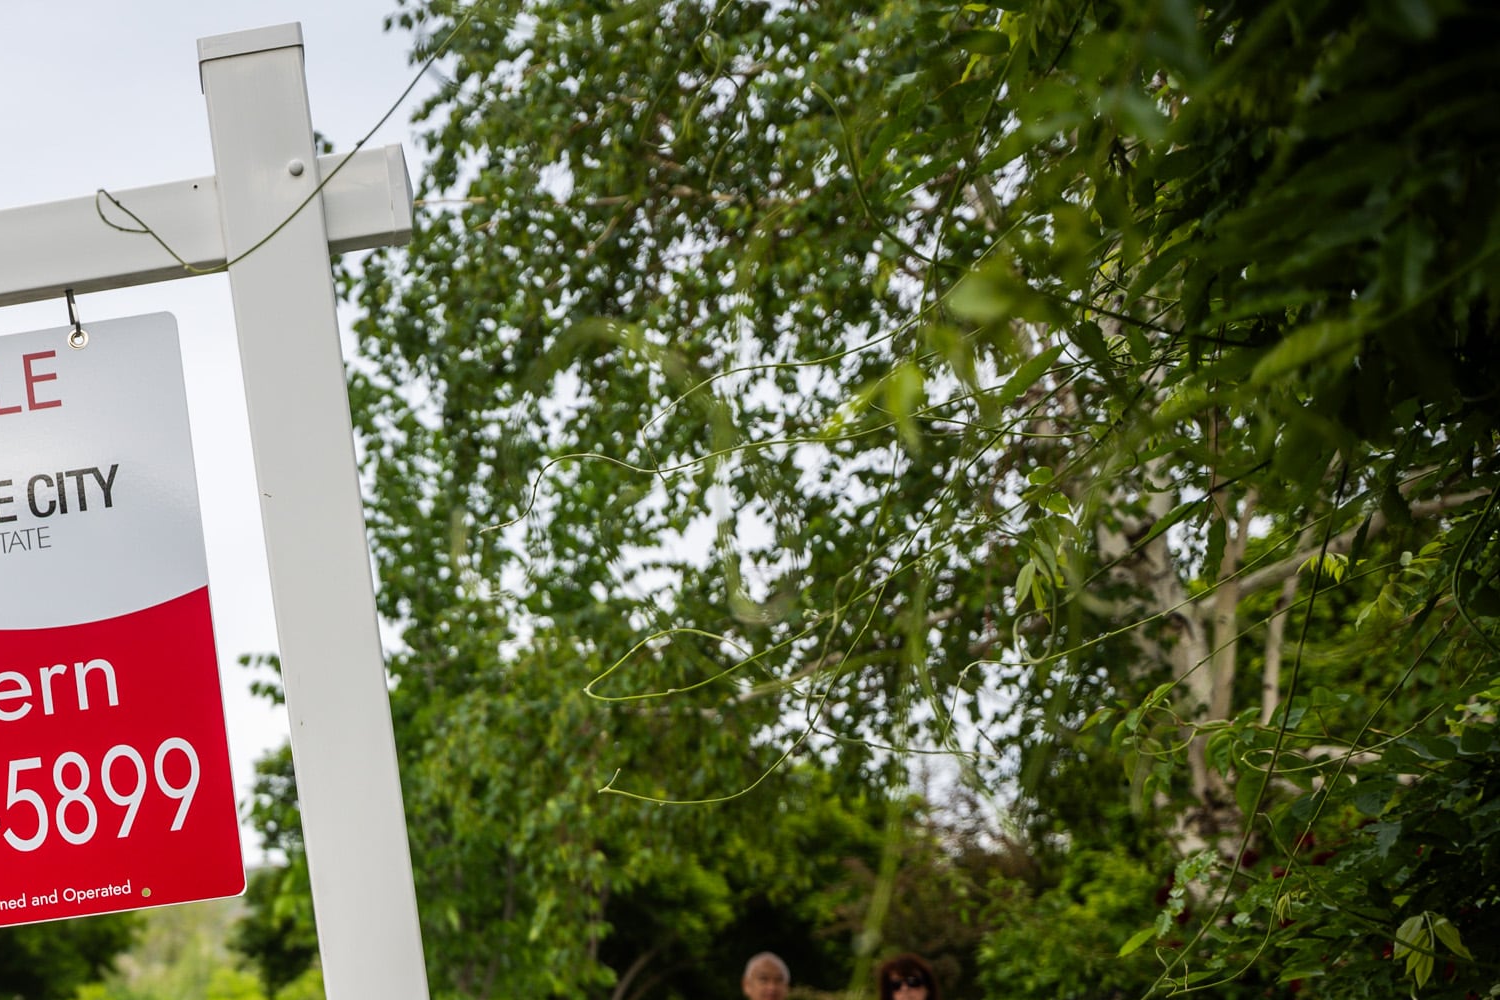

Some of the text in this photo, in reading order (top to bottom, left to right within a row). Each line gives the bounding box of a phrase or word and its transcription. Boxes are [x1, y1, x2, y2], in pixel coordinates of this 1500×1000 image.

[26, 463, 119, 518] CITY
[30, 888, 59, 907] and
[62, 878, 132, 904] Operated
